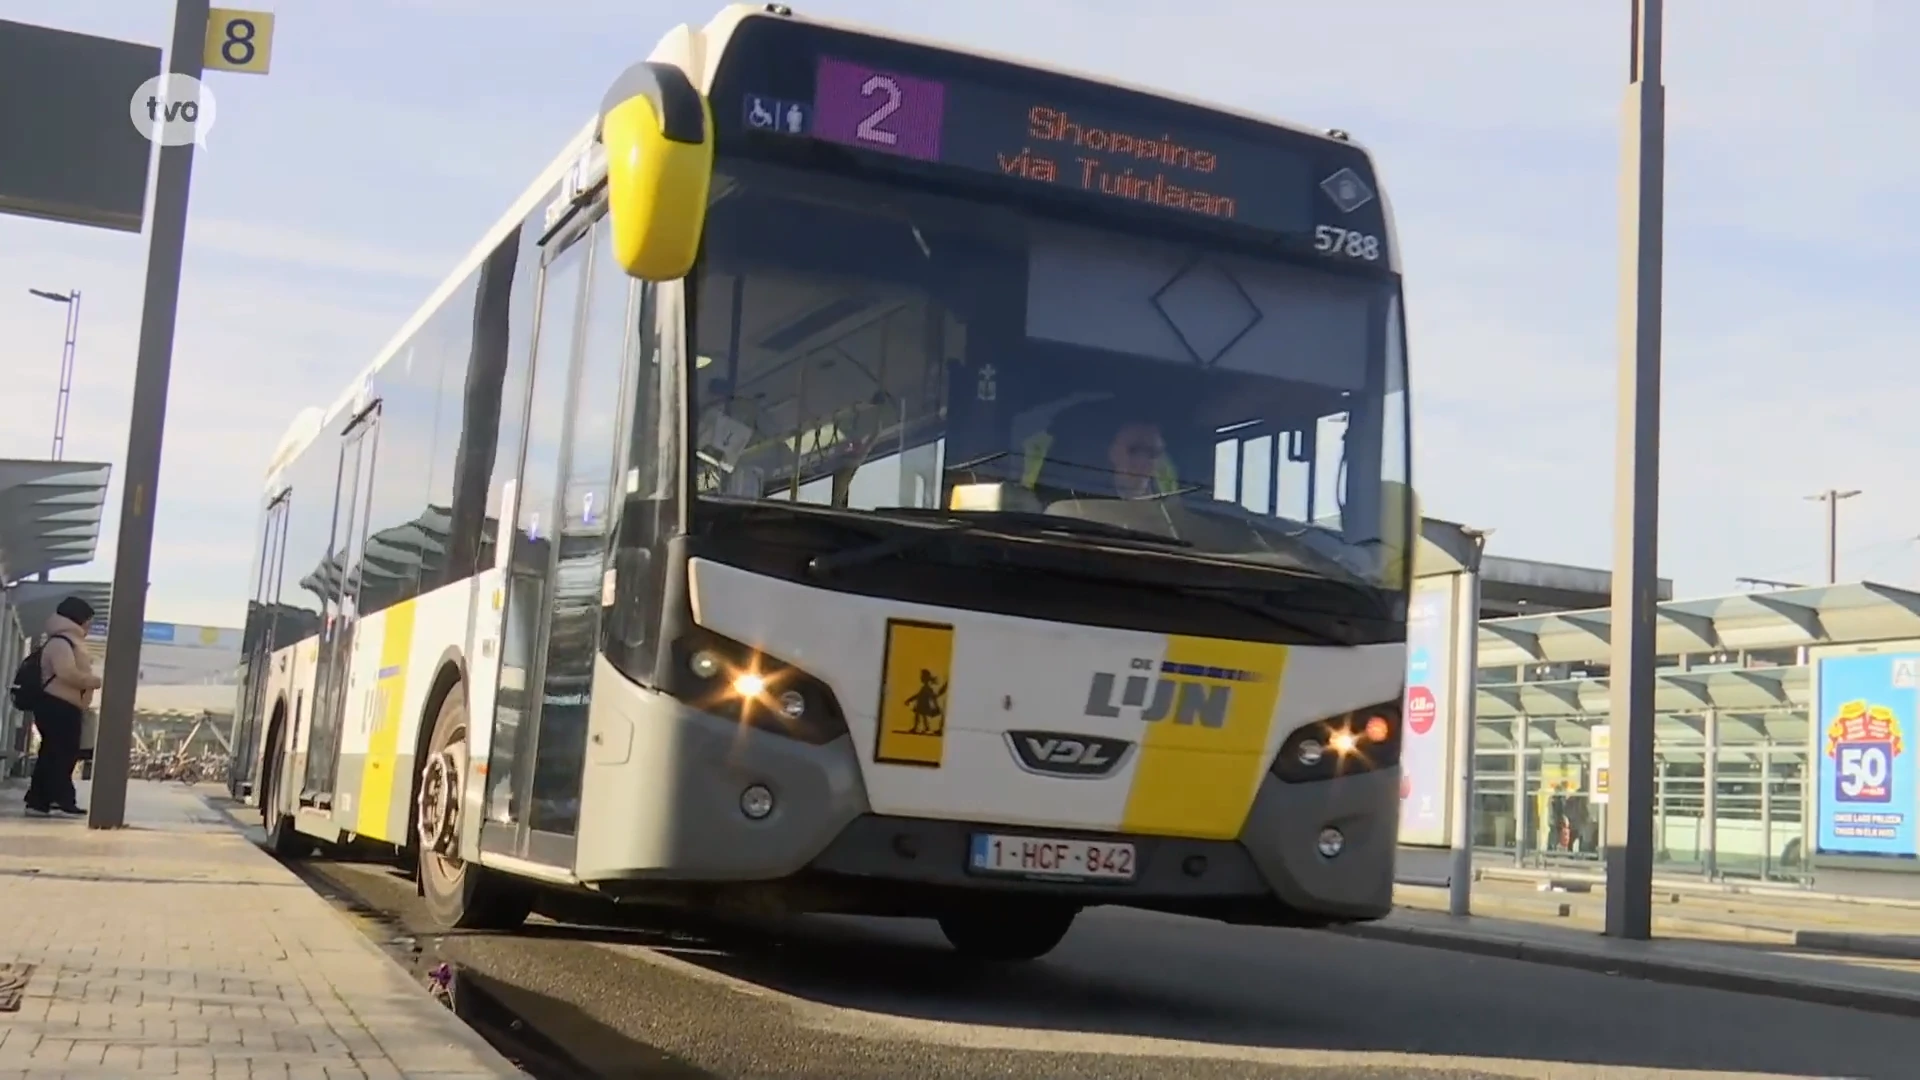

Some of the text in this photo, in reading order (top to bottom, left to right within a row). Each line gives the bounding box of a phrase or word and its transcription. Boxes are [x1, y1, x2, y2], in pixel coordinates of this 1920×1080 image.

[221, 18, 256, 65] 8
[857, 75, 902, 145] 2
[1028, 105, 1217, 174] Shopping
[996, 146, 1236, 219] via Tuinlaan
[1313, 223, 1380, 261] 5788
[1129, 657, 1153, 671] DE
[1084, 670, 1232, 730] LIJN
[1025, 735, 1110, 767] VDL
[1840, 747, 1887, 797] 50
